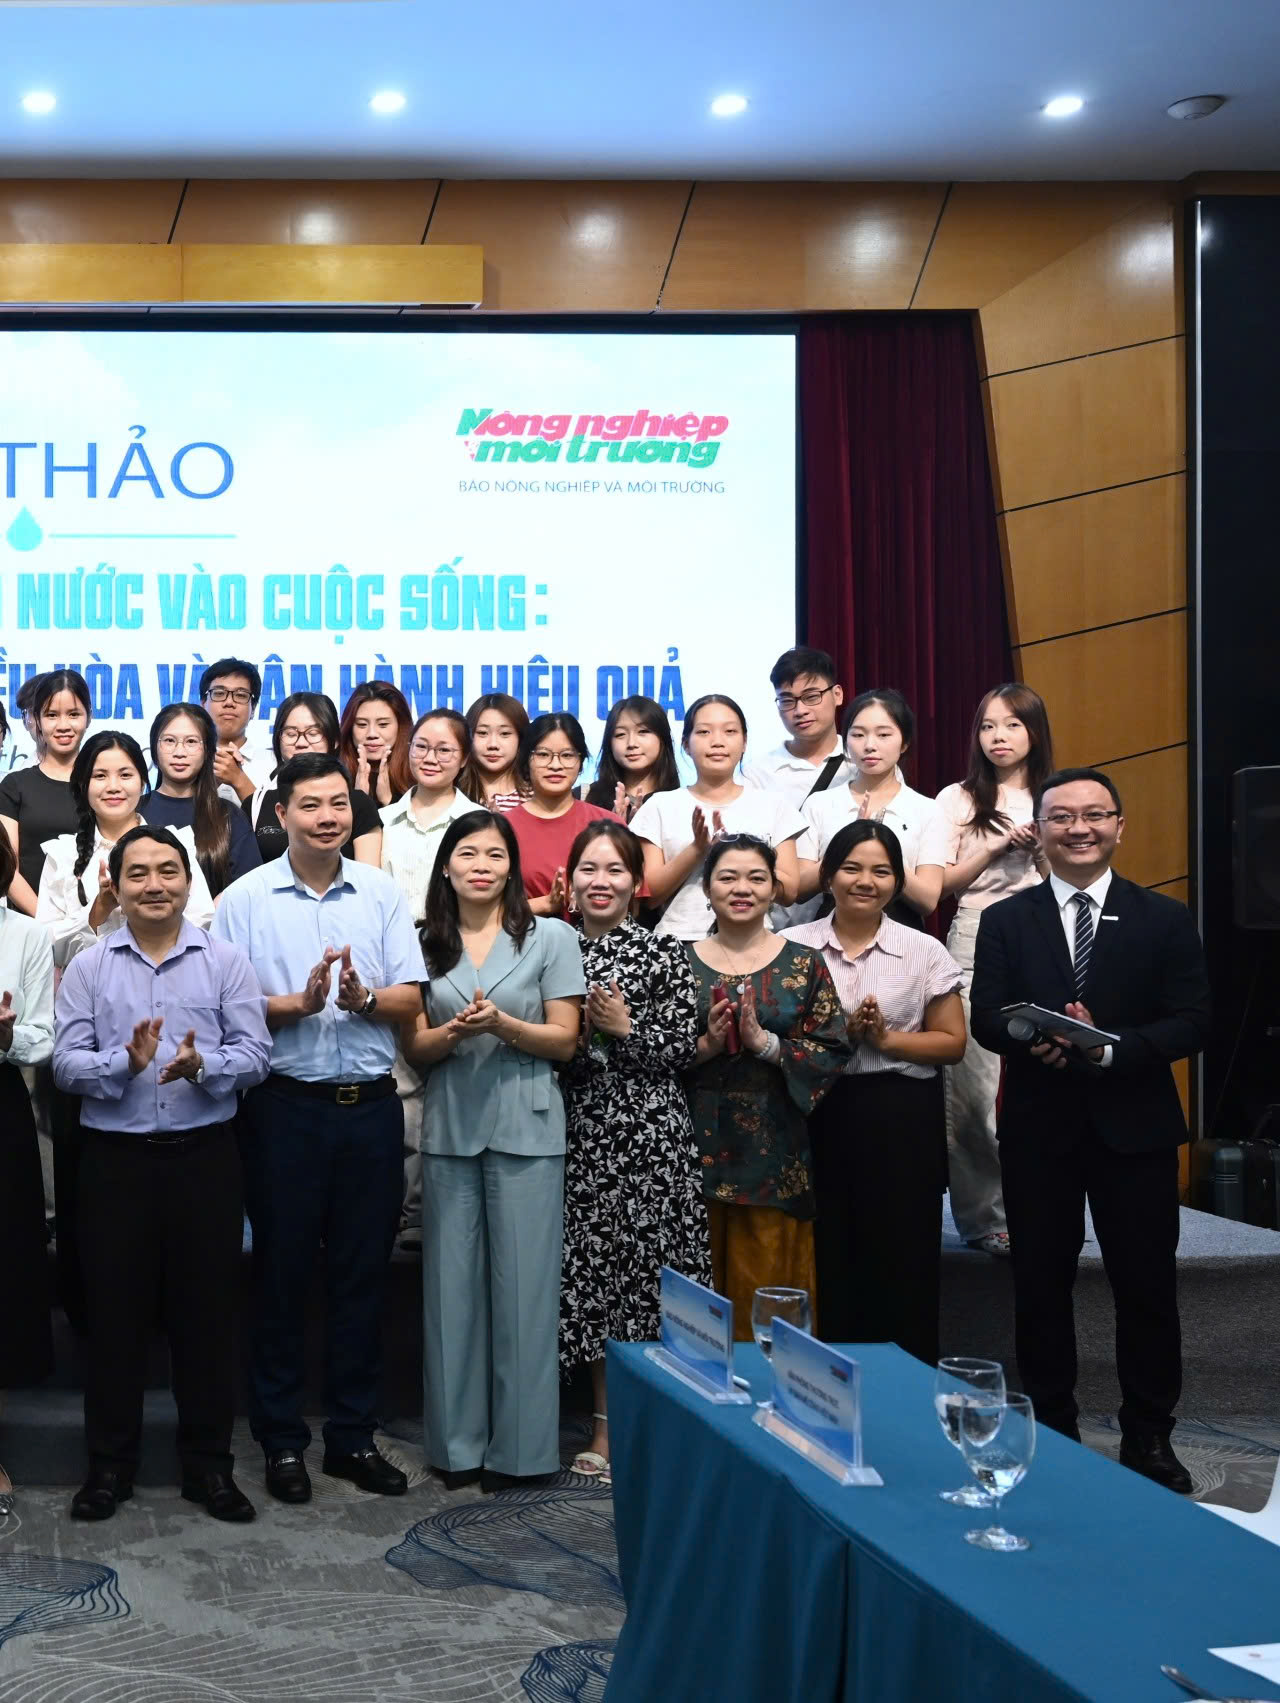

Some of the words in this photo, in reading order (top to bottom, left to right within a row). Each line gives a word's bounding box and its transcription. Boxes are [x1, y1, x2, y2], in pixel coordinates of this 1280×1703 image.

[455, 408, 573, 441] Nông
[574, 409, 730, 442] nghiệp
[17, 562, 144, 630] NƯỚC
[157, 562, 248, 631] VÀO
[263, 563, 385, 645] CUỘC
[399, 556, 548, 631] SỐNG:
[53, 652, 144, 720] ÒA
[255, 653, 323, 734] ẬN
